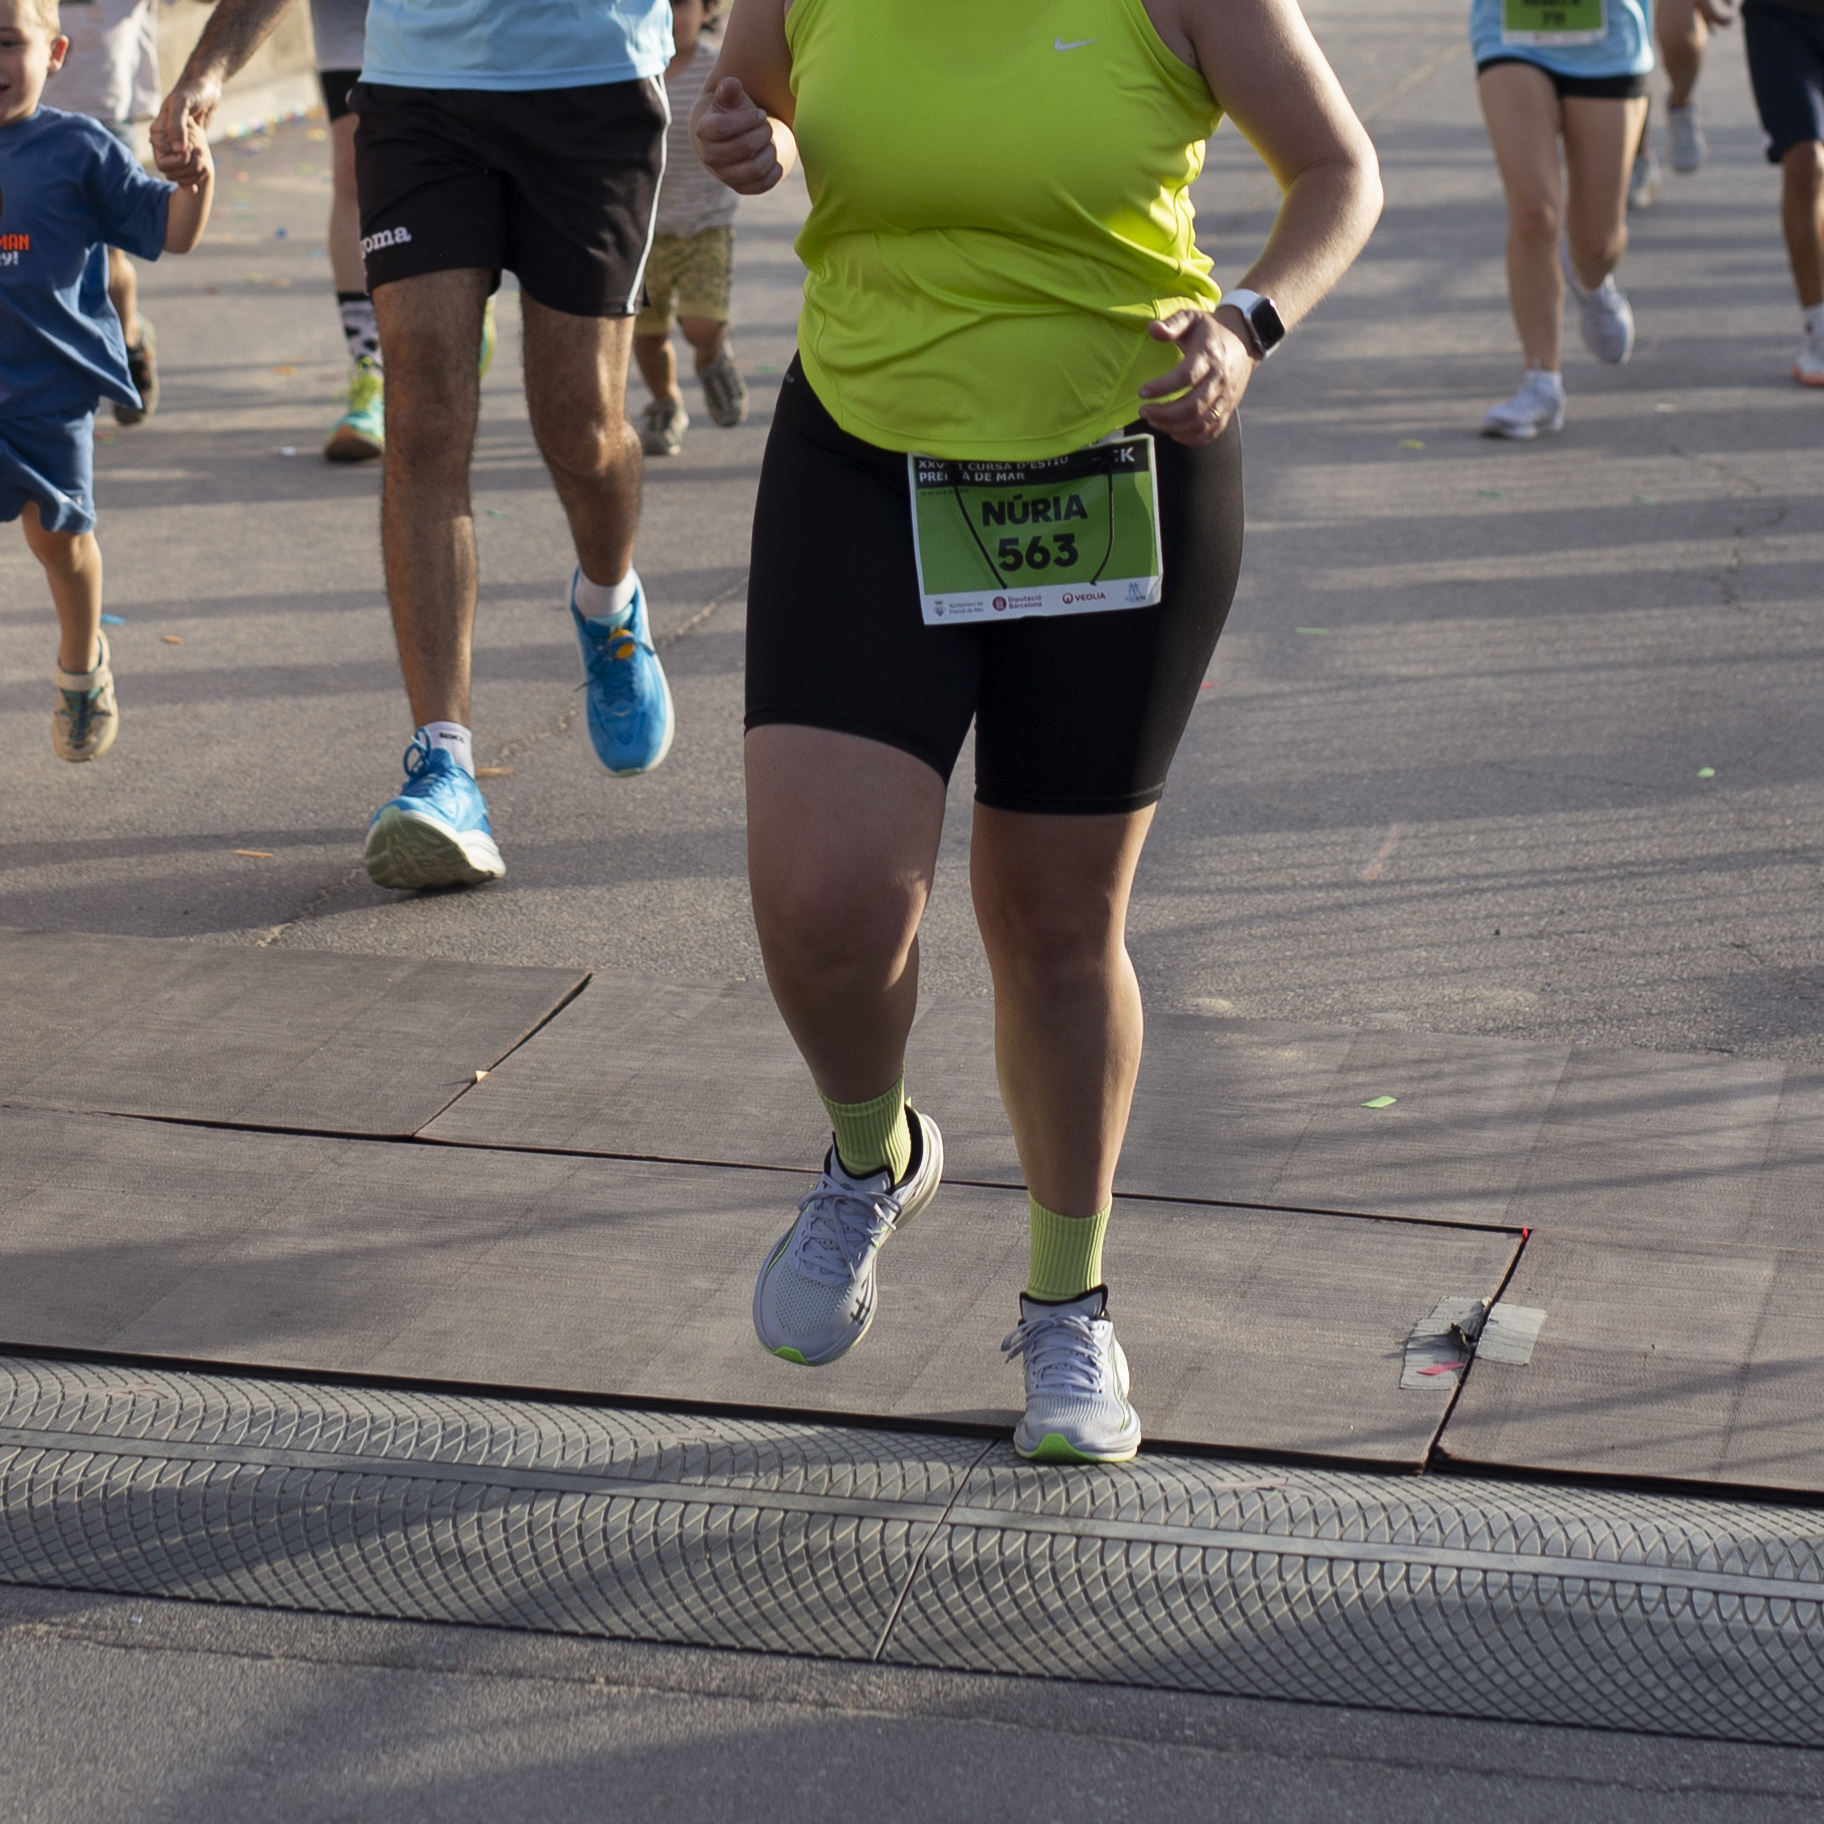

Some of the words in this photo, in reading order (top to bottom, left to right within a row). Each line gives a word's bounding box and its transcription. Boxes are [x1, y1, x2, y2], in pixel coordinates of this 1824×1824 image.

[968, 461, 1012, 471] CURSA
[919, 470, 971, 483] PREÀ
[975, 472, 992, 482] DE
[996, 472, 1025, 482] MAR
[981, 493, 1088, 526] NÚRIA
[997, 533, 1079, 572] 563
[1074, 592, 1107, 602] VEOLIA
